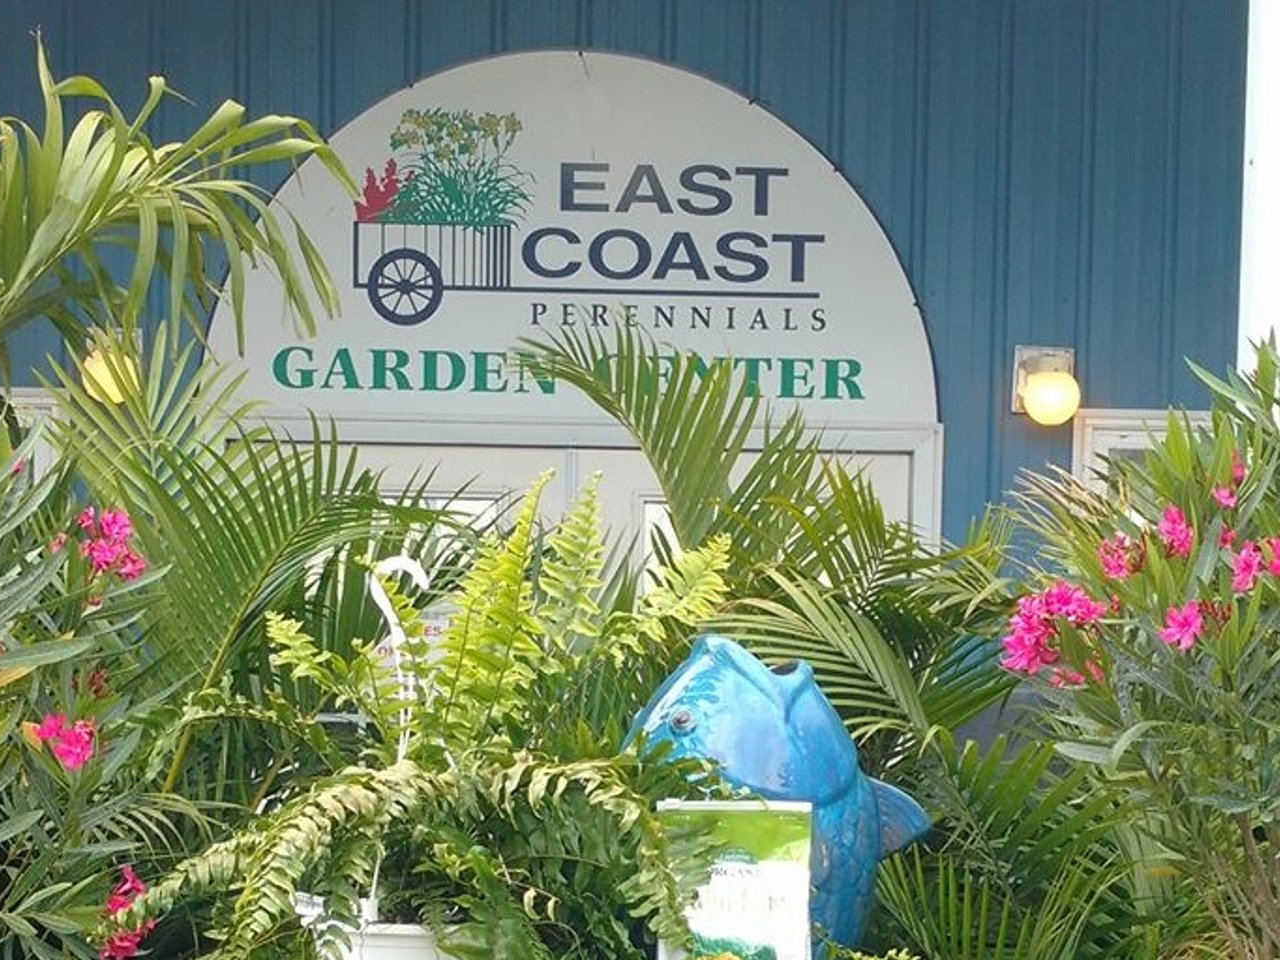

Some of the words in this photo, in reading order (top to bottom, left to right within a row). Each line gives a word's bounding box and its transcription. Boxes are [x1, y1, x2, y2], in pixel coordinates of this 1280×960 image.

[560, 162, 789, 216] EAST
[521, 227, 825, 283] COAST
[531, 303, 826, 332] PERENNIALS
[272, 346, 556, 394] GARDEN
